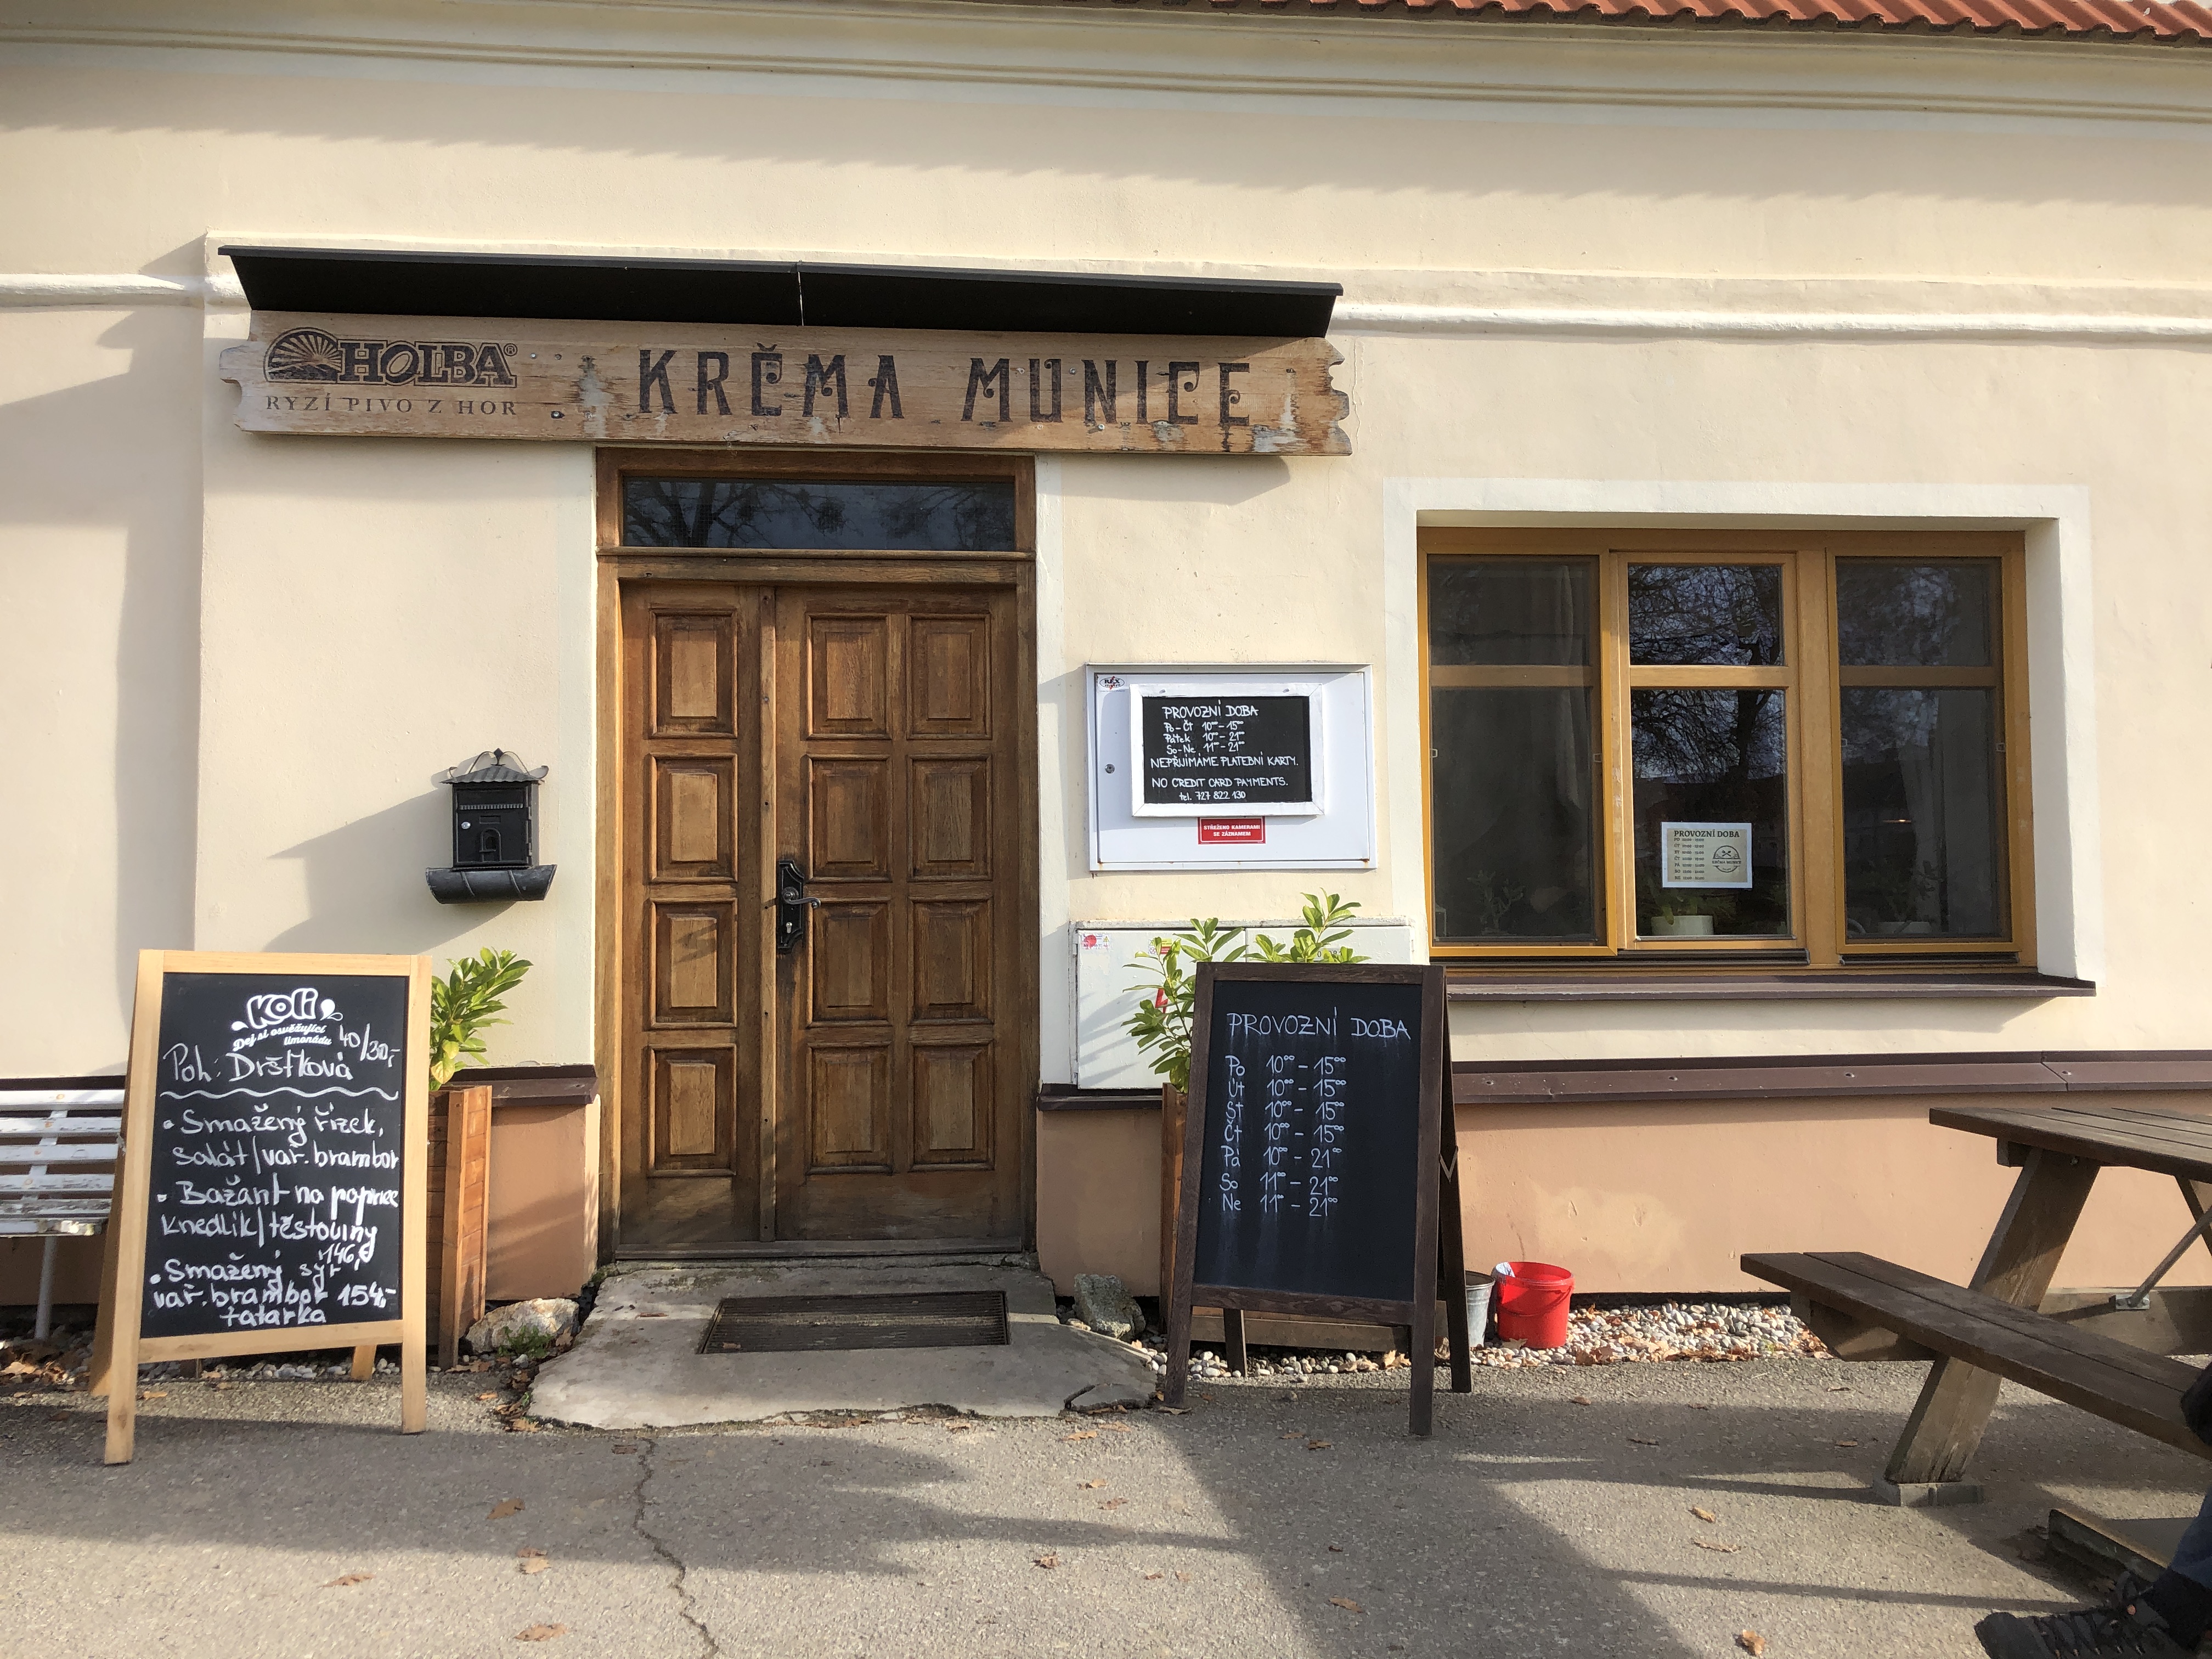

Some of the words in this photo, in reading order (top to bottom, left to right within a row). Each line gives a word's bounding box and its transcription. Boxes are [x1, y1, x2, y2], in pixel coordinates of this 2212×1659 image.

[639, 343, 904, 420] KRČMA
[961, 358, 1250, 426] MUNICE
[266, 393, 330, 411] RYZÍ
[349, 397, 413, 413] PIVO
[428, 400, 442, 414] Z
[459, 400, 516, 415] HOR
[1161, 699, 1221, 719] PROVOZNÍ
[1225, 705, 1259, 717] DOBA
[1163, 733, 1190, 743] Pátek
[1221, 752, 1263, 766] PLATEBNÍ
[1267, 757, 1299, 766] KARTY.
[1152, 777, 1167, 788] NO
[1172, 778, 1205, 787] CREDIT
[1209, 778, 1233, 787] CARD
[1234, 777, 1289, 787] PAYMENTS.
[1195, 791, 1211, 800] 727
[1213, 791, 1230, 799] 822
[1232, 791, 1246, 799] 130
[1674, 829, 1715, 837] PROVOZNÍ
[1227, 1007, 1338, 1036] PROVOZNÍ
[1351, 1018, 1411, 1040] DOBA
[233, 1034, 257, 1052] Dej
[257, 1029, 269, 1041] si
[270, 1023, 327, 1036] osvěžující
[284, 1035, 332, 1046] limonádu
[1225, 1055, 1245, 1076] Po
[1228, 1078, 1244, 1097] Út
[1226, 1101, 1244, 1119] St
[180, 1103, 308, 1147] Smažený
[1224, 1119, 1242, 1142] Čt
[1221, 1145, 1240, 1167] Pá
[176, 1173, 290, 1207] Bažant
[1220, 1173, 1238, 1190] So
[1223, 1193, 1241, 1211] Ne
[165, 1249, 283, 1292] Smažený
[219, 1302, 326, 1327] tatarka
